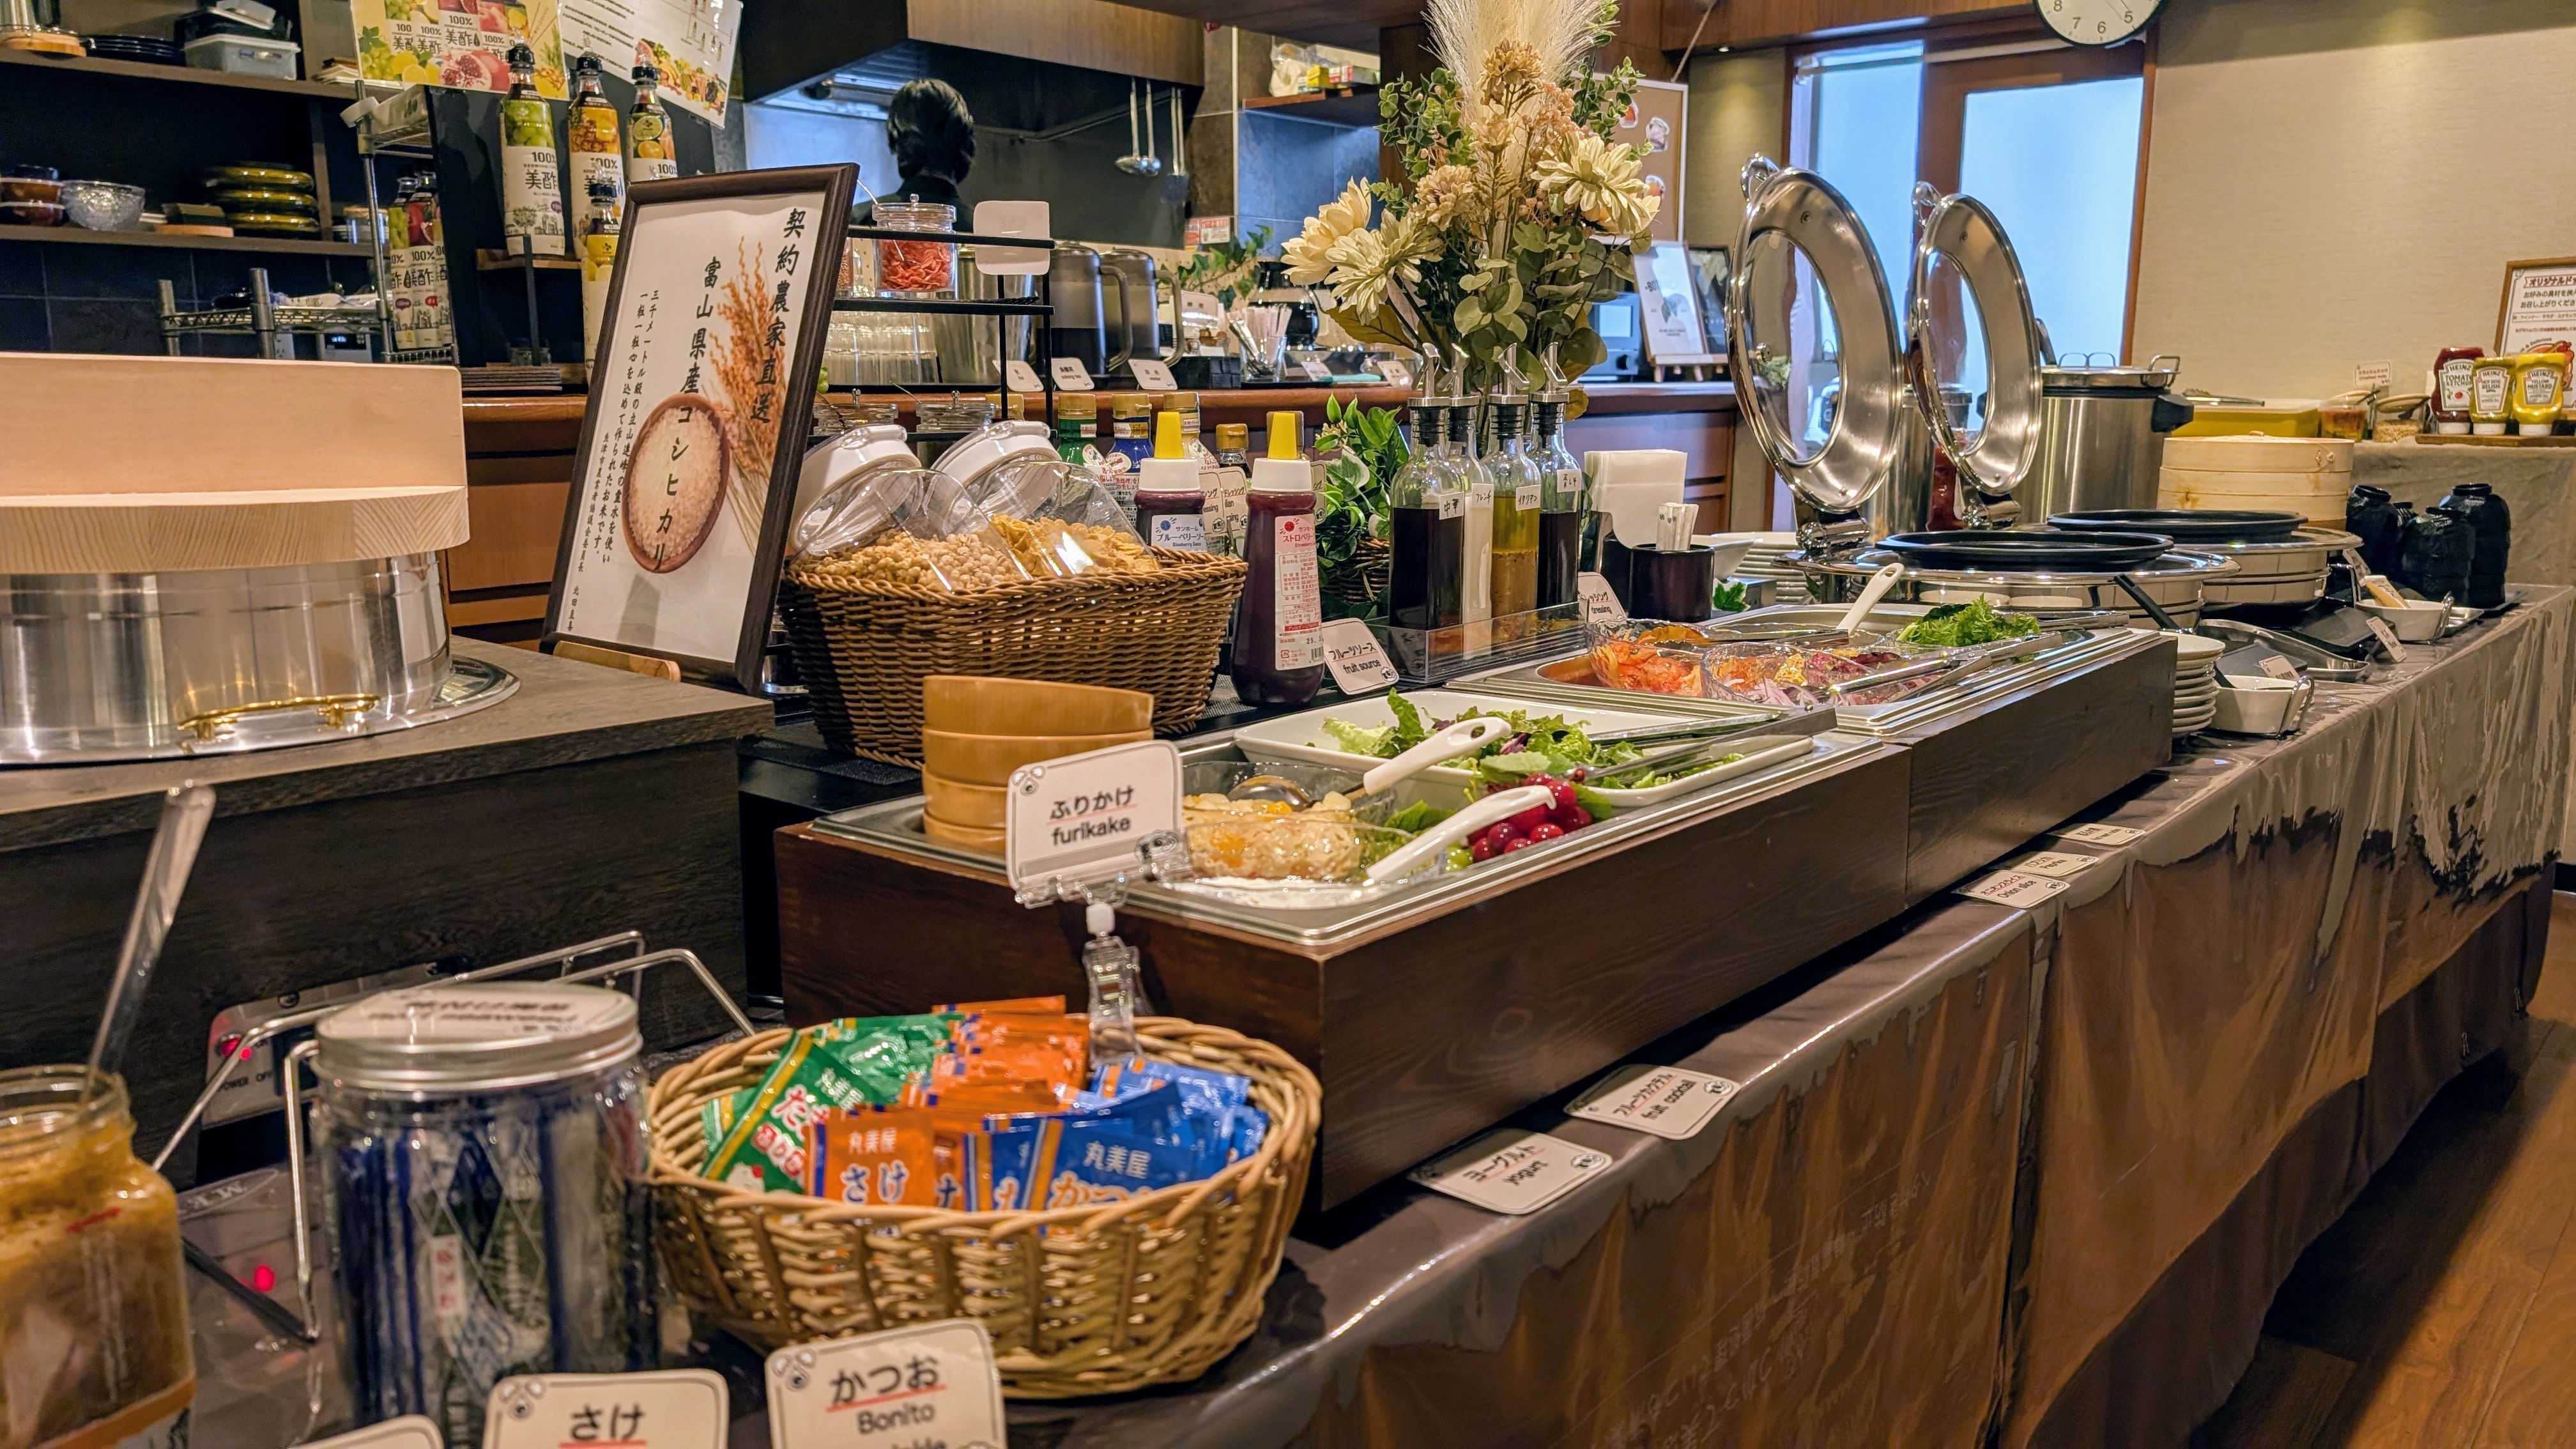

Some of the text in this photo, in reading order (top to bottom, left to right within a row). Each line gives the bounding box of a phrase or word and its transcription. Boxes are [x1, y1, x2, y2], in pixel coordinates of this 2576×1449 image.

[2053, 0, 2062, 12] 8
[2124, 10, 2133, 24] 5
[420, 26, 441, 35] 100%
[449, 15, 473, 26] 100%
[2073, 17, 2081, 29] 7
[2097, 21, 2106, 34] 6
[484, 34, 505, 44] 100%
[750, 208, 806, 423] 契約農家直送
[2449, 363, 2472, 372] HEINZ
[652, 257, 722, 570] 富山県産コシヒカリ
[1203, 503, 1219, 513] essing
[1156, 532, 1207, 542] ブルーベリーソー
[1328, 642, 1377, 661] フルーツソース
[1342, 659, 1381, 675] fruit source
[1050, 785, 1135, 820] ふりかけ
[1052, 816, 1132, 847] furikake
[1997, 887, 2020, 898] Onion
[1612, 1073, 1673, 1116] フルーツカクテル
[848, 1127, 897, 1154] 丸美屋
[1084, 1140, 1151, 1179] 丸美屋
[1462, 1145, 1537, 1183] ヨーグルト
[841, 1158, 910, 1206] さけ
[1048, 1170, 1154, 1210] かつ
[829, 1354, 942, 1406] かつお
[570, 1404, 646, 1441] さけ
[857, 1404, 936, 1436] Bonito
